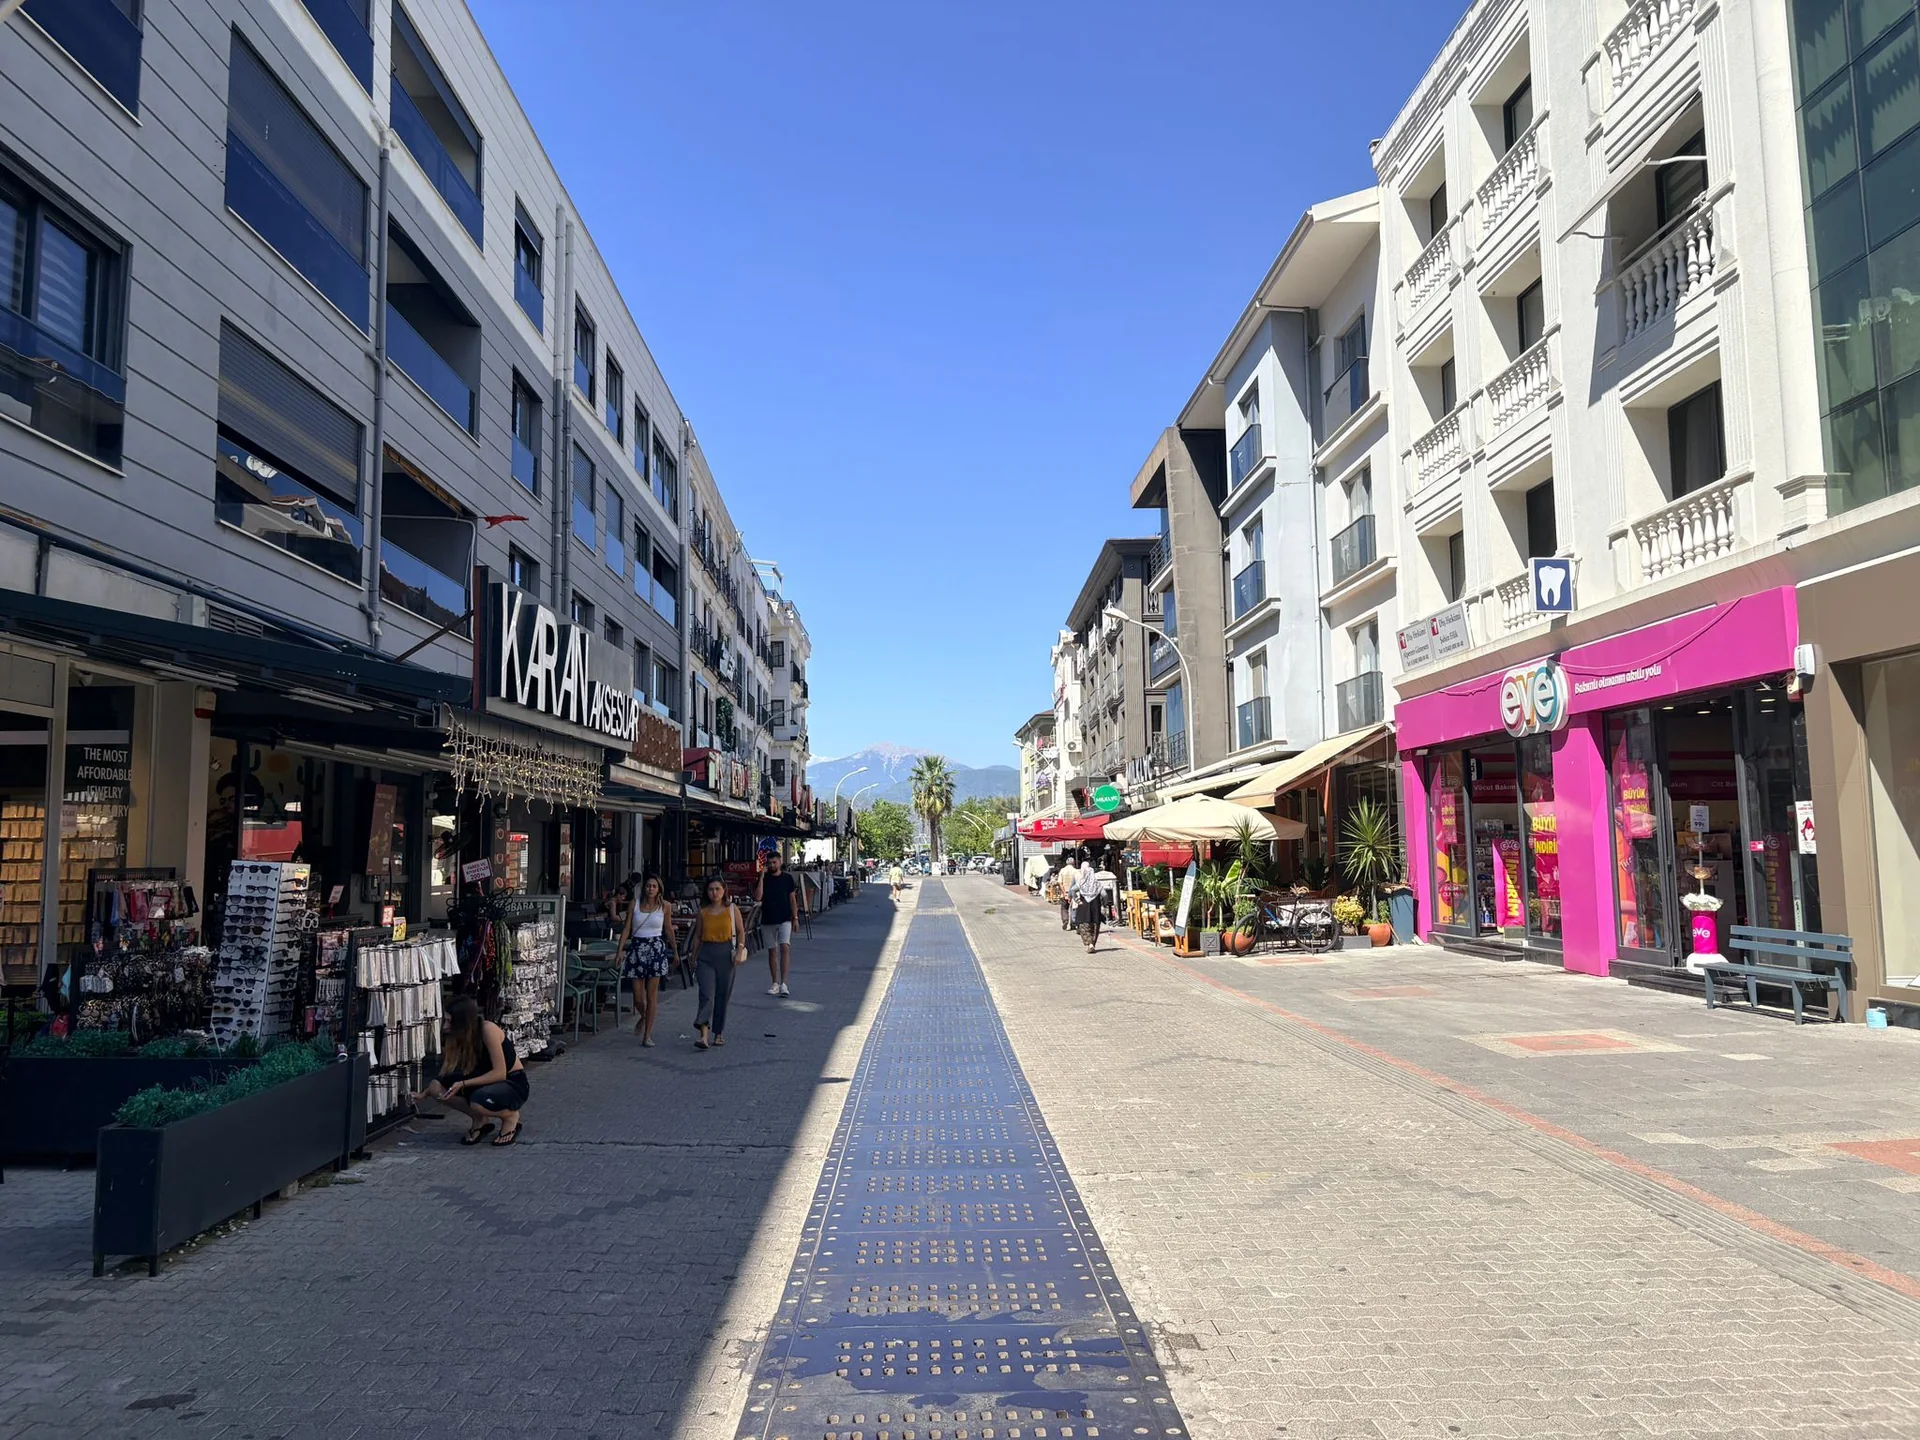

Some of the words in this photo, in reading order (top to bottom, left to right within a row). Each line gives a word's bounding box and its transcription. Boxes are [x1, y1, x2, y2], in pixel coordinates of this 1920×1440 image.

[501, 582, 589, 727] KARAN
[589, 681, 639, 742] AKSESUAR
[1644, 664, 1662, 681] yolu
[1501, 667, 1558, 729] eve
[84, 747, 102, 761] THE
[103, 749, 128, 763] MOST
[77, 765, 132, 781] AFFORDABLE
[87, 785, 124, 799] JEWELRY
[1623, 786, 1646, 800] BÜYÜK
